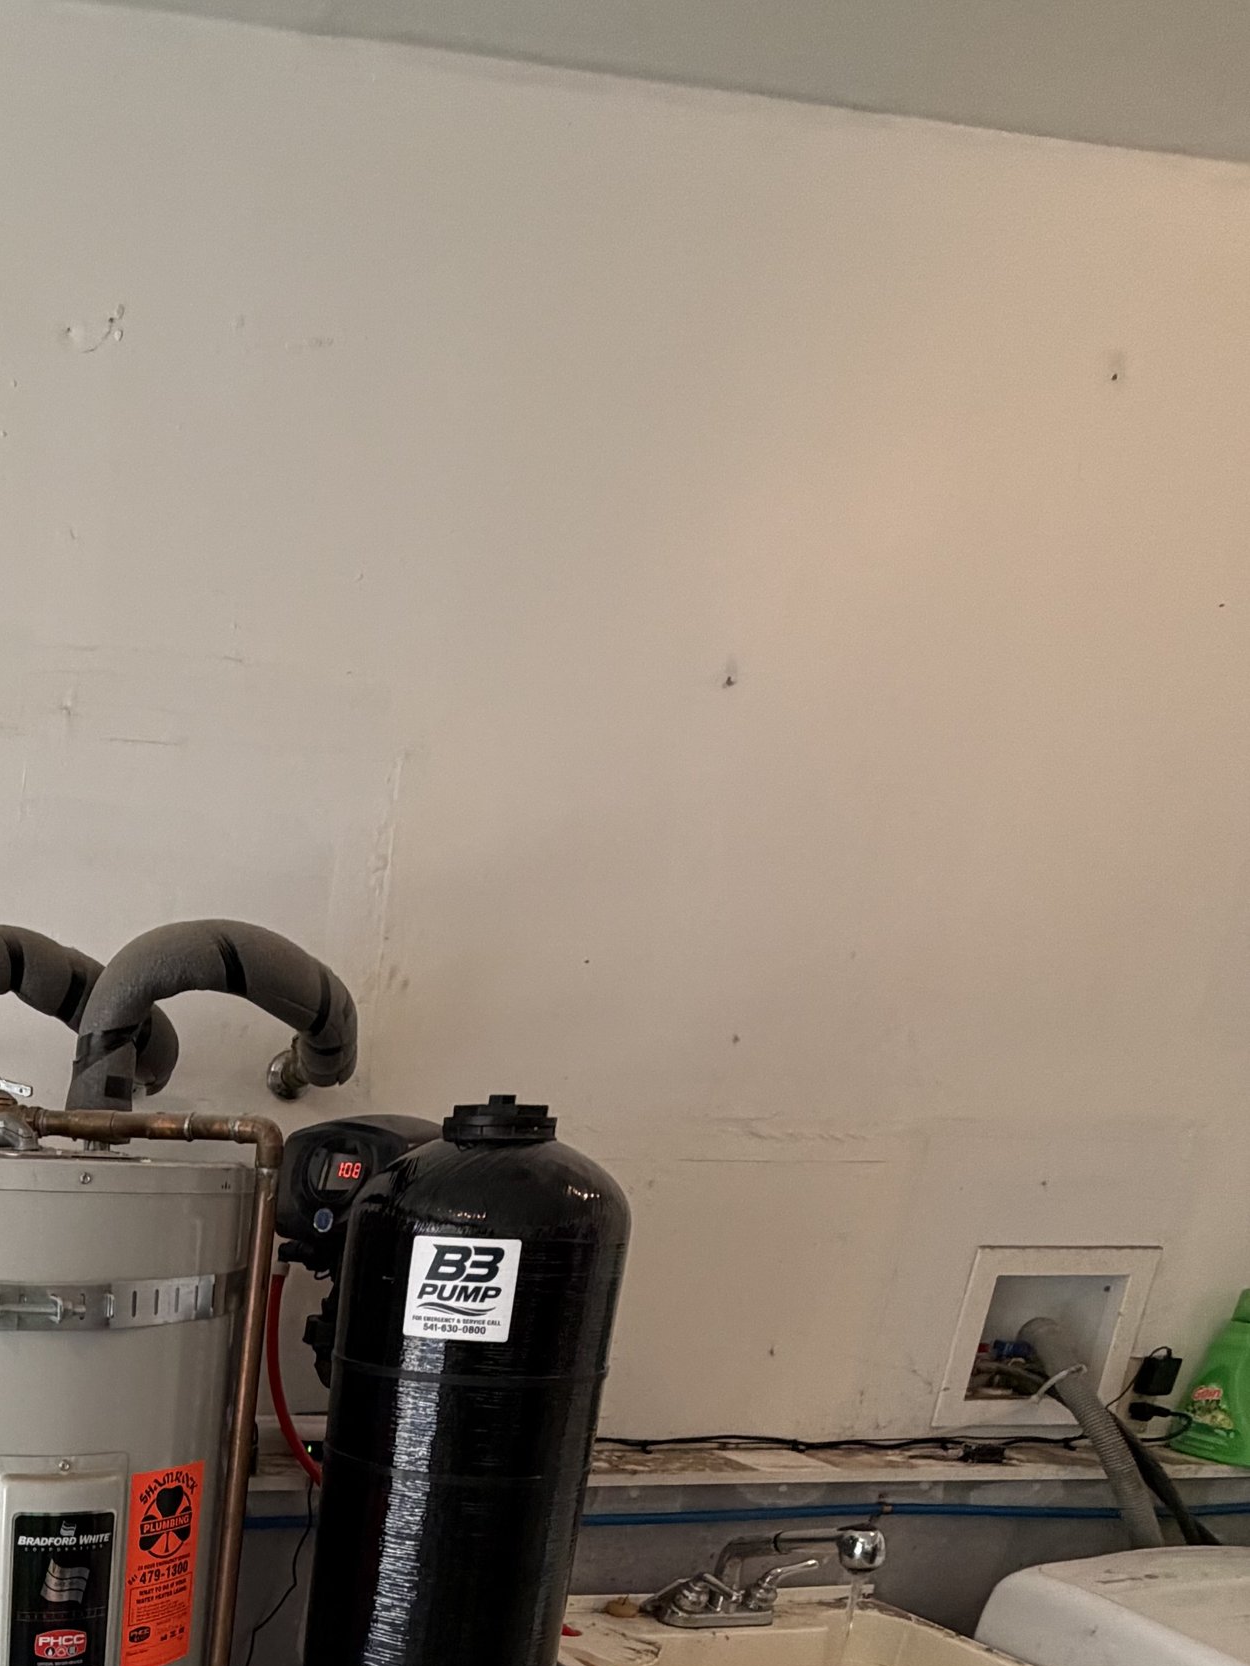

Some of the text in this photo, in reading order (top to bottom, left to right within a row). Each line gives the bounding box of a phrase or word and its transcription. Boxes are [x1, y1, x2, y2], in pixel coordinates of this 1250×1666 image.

[338, 1162, 362, 1179] 108
[425, 1244, 505, 1283] B3
[417, 1283, 502, 1303] PUMP
[423, 1316, 456, 1324] EMERGENCY
[423, 1323, 486, 1335] 541-630-0800
[143, 1515, 189, 1533] PLUMBING
[17, 1533, 110, 1547] BRADFORD WHITE
[140, 1560, 188, 1584] 479-1300
[38, 1634, 85, 1646] PHCC
